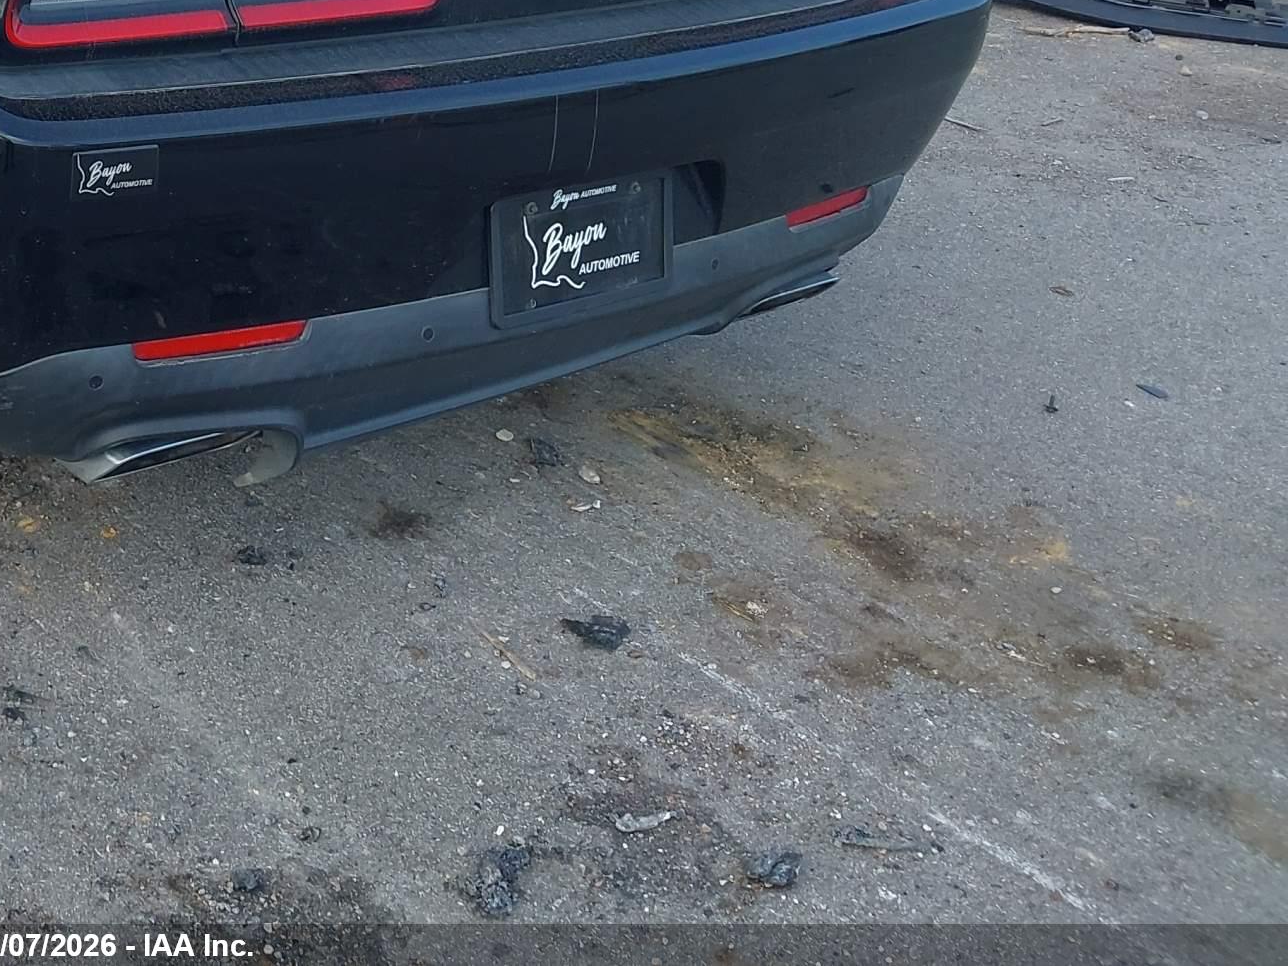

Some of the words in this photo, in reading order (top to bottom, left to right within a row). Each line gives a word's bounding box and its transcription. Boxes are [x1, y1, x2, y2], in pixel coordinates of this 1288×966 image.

[110, 178, 153, 190] AUTOMOTIVE
[580, 184, 617, 199] AUTOMOTIVE
[578, 251, 640, 276] AUTOMOTIVE
